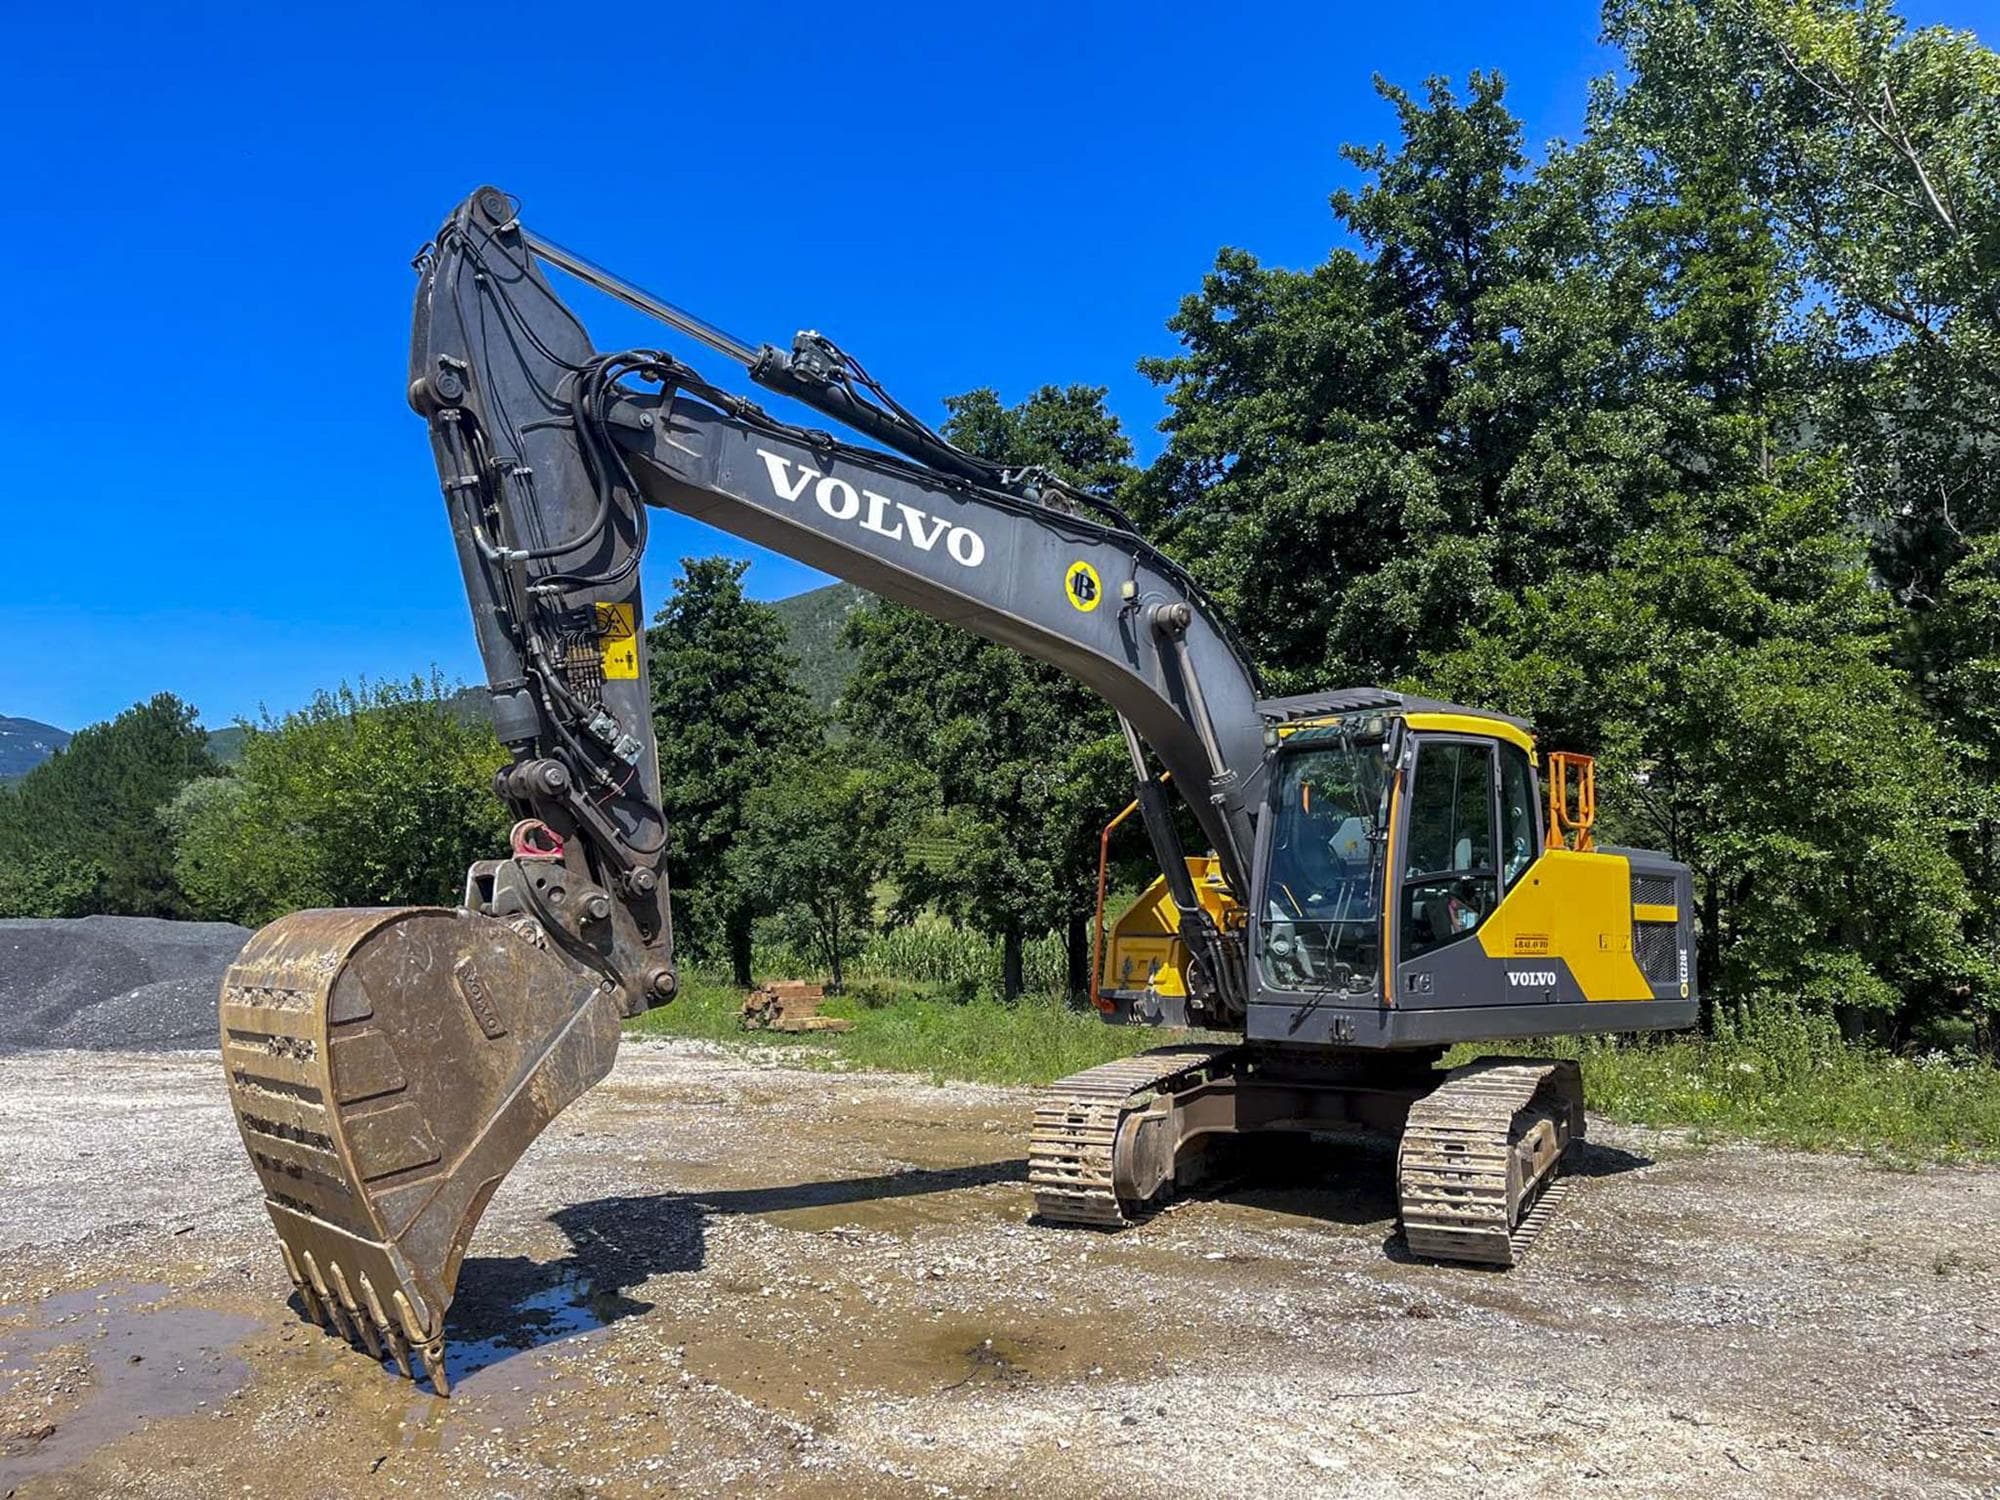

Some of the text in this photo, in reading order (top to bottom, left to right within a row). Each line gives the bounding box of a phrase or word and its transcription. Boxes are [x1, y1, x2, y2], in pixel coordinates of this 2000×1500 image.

[756, 448, 985, 567] VOLVO
[1507, 971, 1556, 986] VOLVO
[1680, 949, 1688, 983] EC220E
